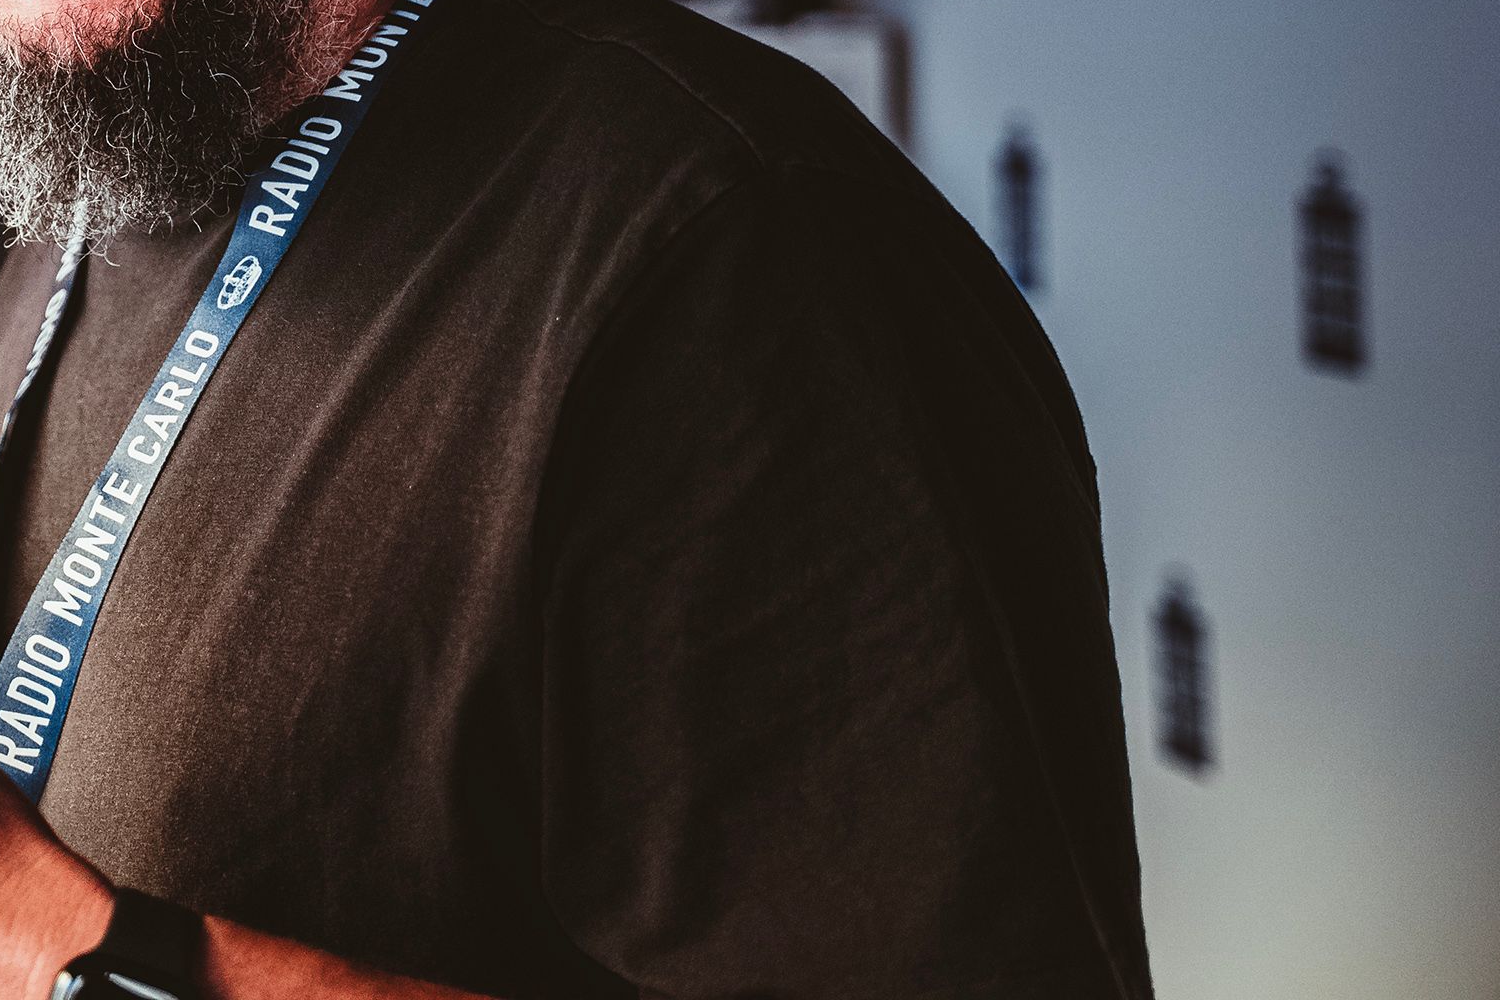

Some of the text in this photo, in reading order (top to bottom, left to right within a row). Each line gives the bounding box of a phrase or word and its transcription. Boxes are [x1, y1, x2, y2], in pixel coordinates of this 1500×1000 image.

[249, 116, 342, 237] RADIO
[43, 470, 142, 627] MONTE
[126, 328, 220, 465] CARLO
